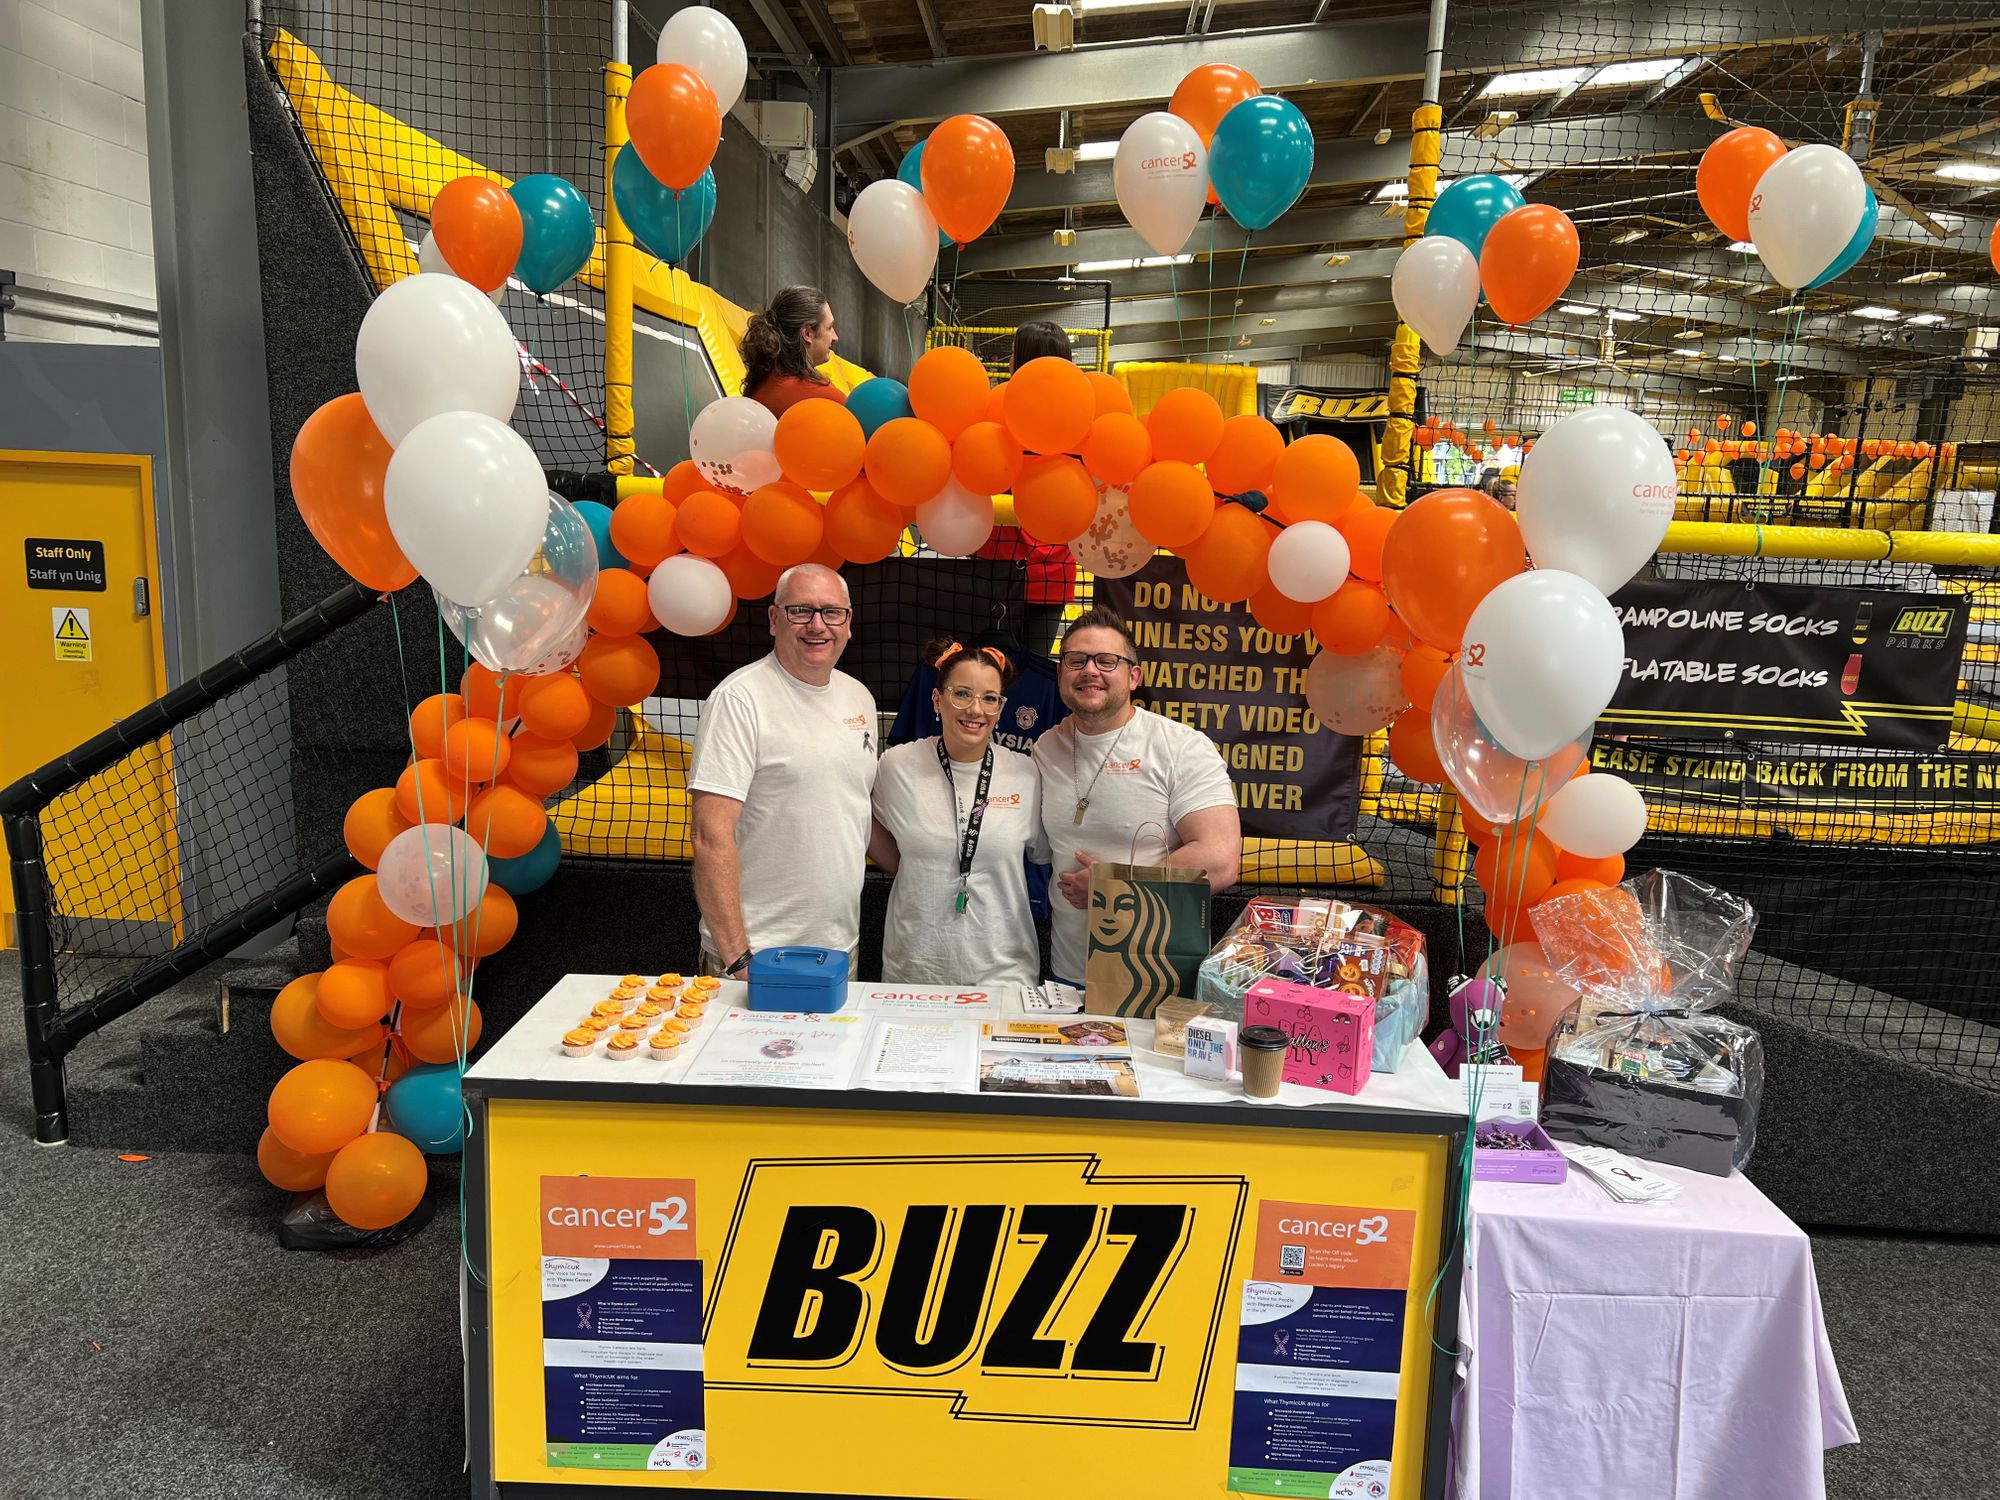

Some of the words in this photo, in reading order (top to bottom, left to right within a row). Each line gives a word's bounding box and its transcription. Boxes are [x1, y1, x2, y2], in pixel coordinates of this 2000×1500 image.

[1286, 394, 1390, 418] BUZZ
[36, 547, 64, 558] Staff
[66, 548, 91, 562] Only
[30, 568, 57, 580] Staff
[60, 572, 73, 582] yn
[76, 570, 102, 584] Unig
[1134, 582, 1172, 610] DO
[1182, 584, 1232, 612] NO
[1748, 612, 1840, 636] SOCKS
[1896, 612, 1949, 633] BUZZ
[1886, 636, 1946, 650] PARKS
[1139, 661, 1263, 693] WATCHED
[1741, 664, 1828, 688] SOCKS
[1238, 704, 1320, 734] VIDEO
[1214, 743, 1304, 772] IGNED
[1664, 755, 1747, 784] STAND
[1756, 760, 1826, 786] BACK
[1832, 762, 1909, 788] FROM
[1917, 763, 1969, 788] THE
[1976, 764, 2000, 789] N
[870, 992, 988, 1004] cancer52
[1188, 1038, 1206, 1050] ONLY
[1210, 1042, 1223, 1054] THE
[1189, 1028, 1213, 1041] DIESEL
[1287, 1033, 1329, 1052] allows
[1188, 1048, 1212, 1061] BRAVE
[547, 1196, 688, 1236] cancer52
[1278, 1216, 1389, 1246] cancer52
[746, 1204, 1196, 1382] BUZZ
